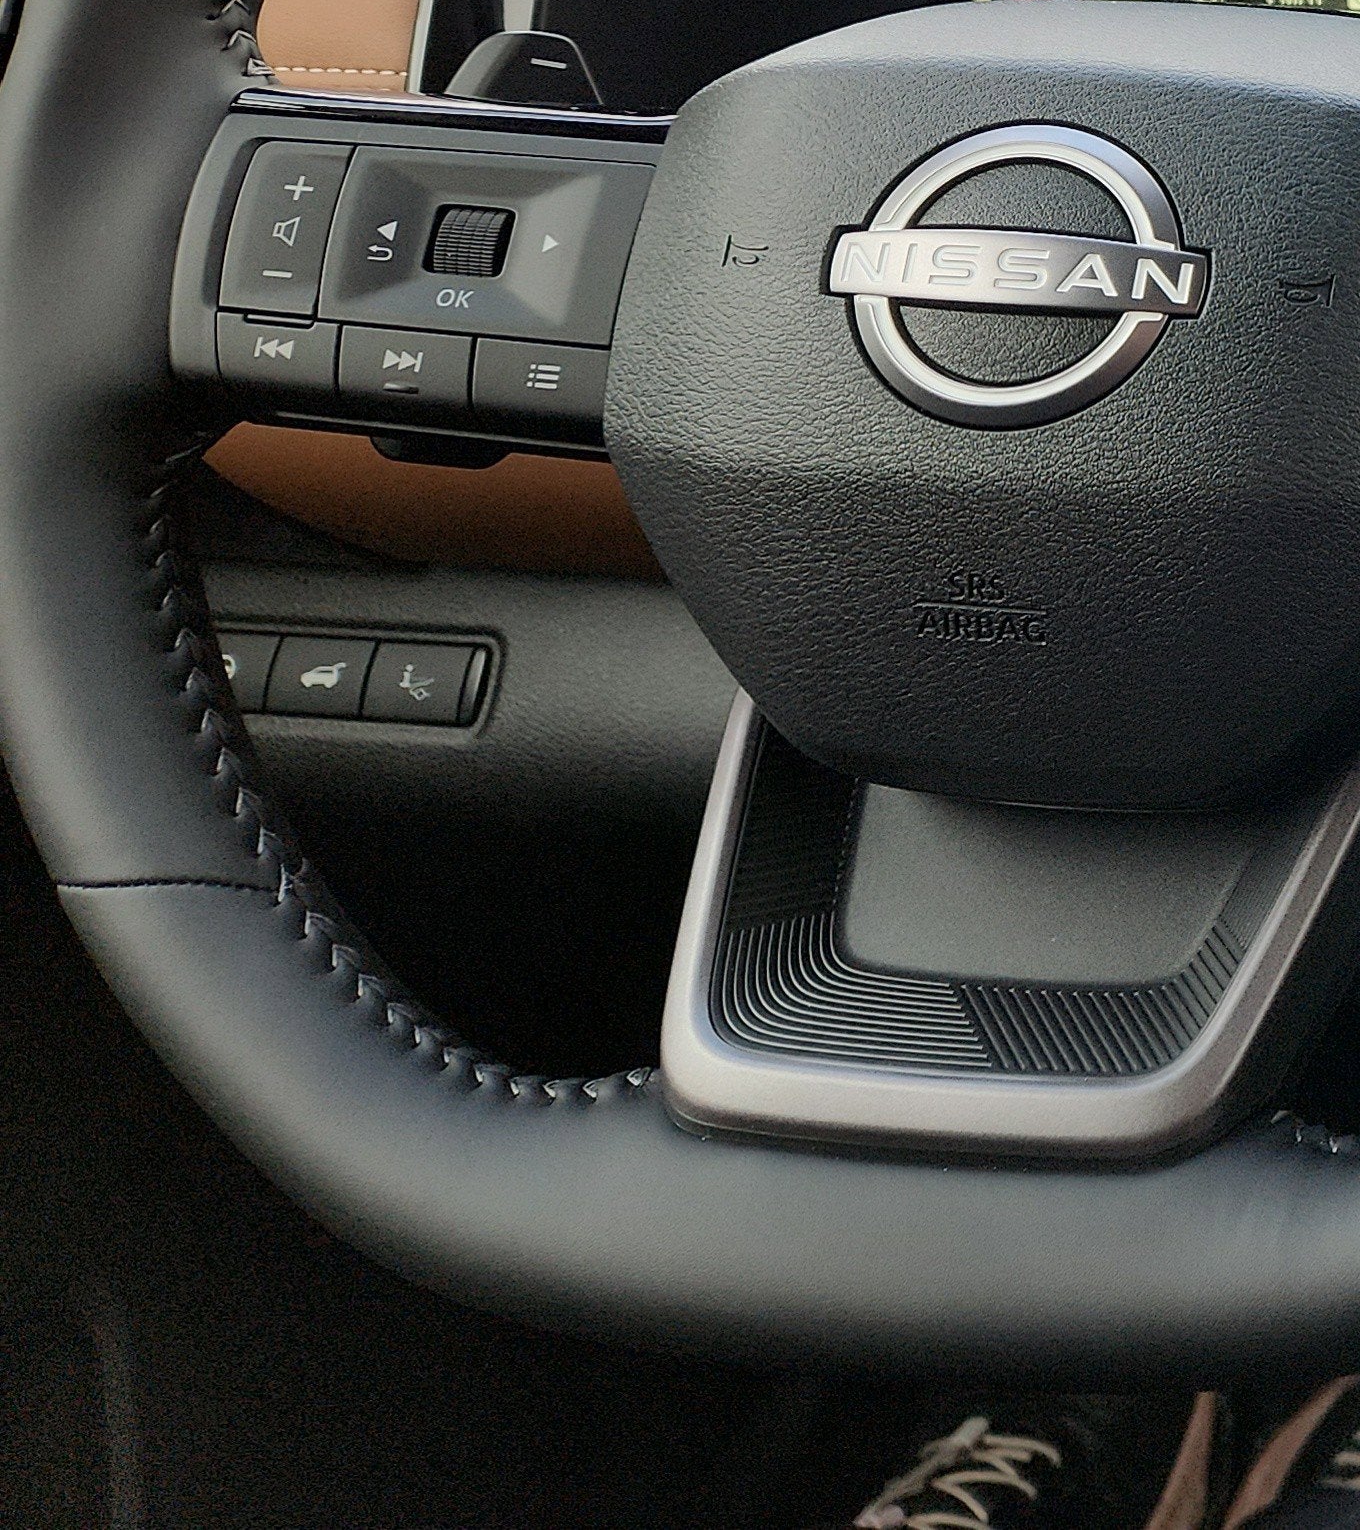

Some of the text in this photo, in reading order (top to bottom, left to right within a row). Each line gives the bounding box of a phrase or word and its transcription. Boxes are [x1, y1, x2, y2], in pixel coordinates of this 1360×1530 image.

[840, 241, 1195, 304] NISSAN
[436, 288, 474, 309] OK
[946, 574, 1005, 603] SRS
[916, 612, 1046, 645] AIRBAG
